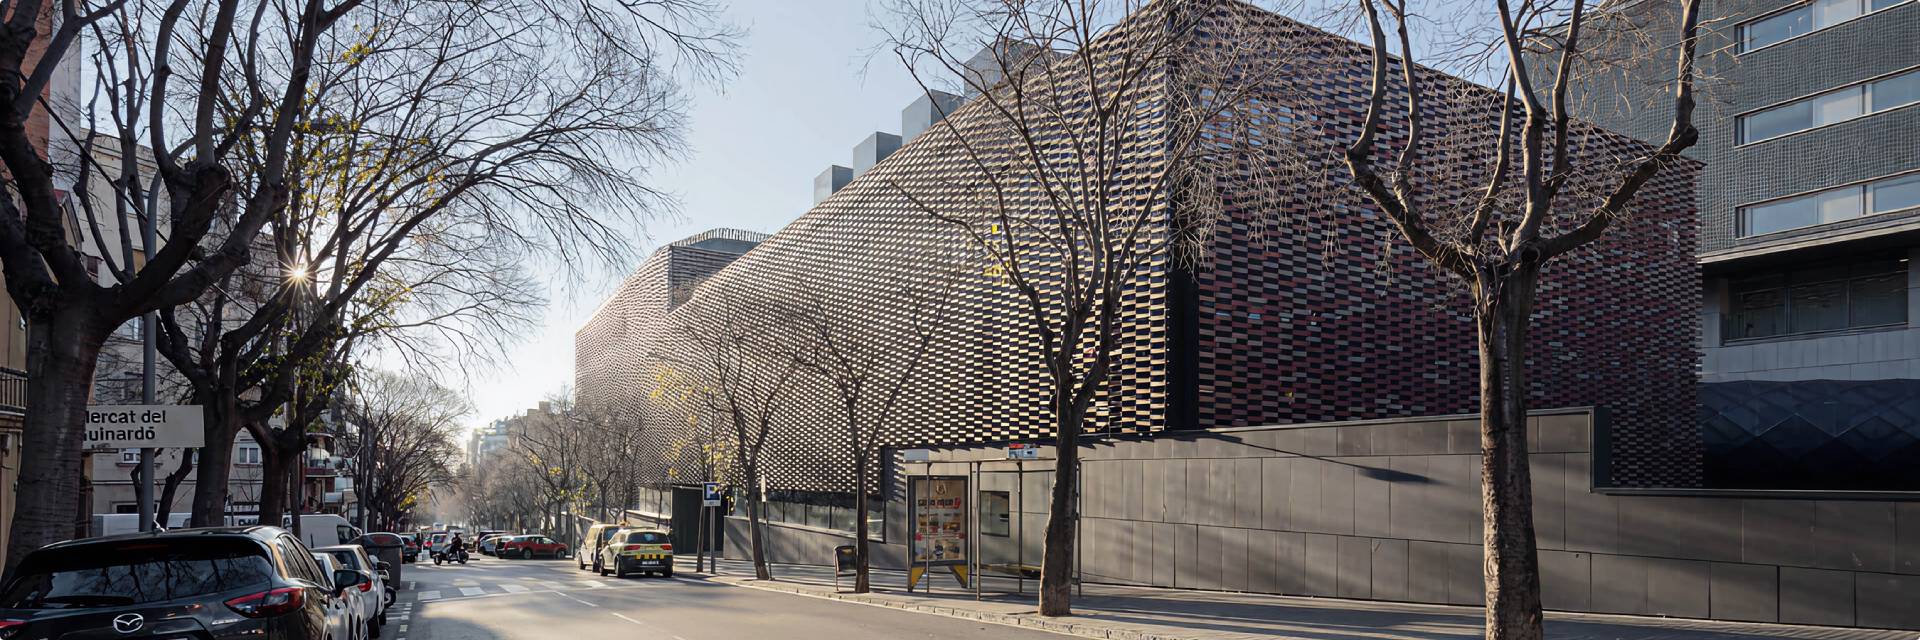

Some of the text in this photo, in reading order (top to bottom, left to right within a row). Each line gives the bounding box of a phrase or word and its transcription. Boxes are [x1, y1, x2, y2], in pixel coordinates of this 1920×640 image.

[141, 409, 167, 423] del
[84, 426, 156, 441] uinardó
[706, 484, 718, 499] P
